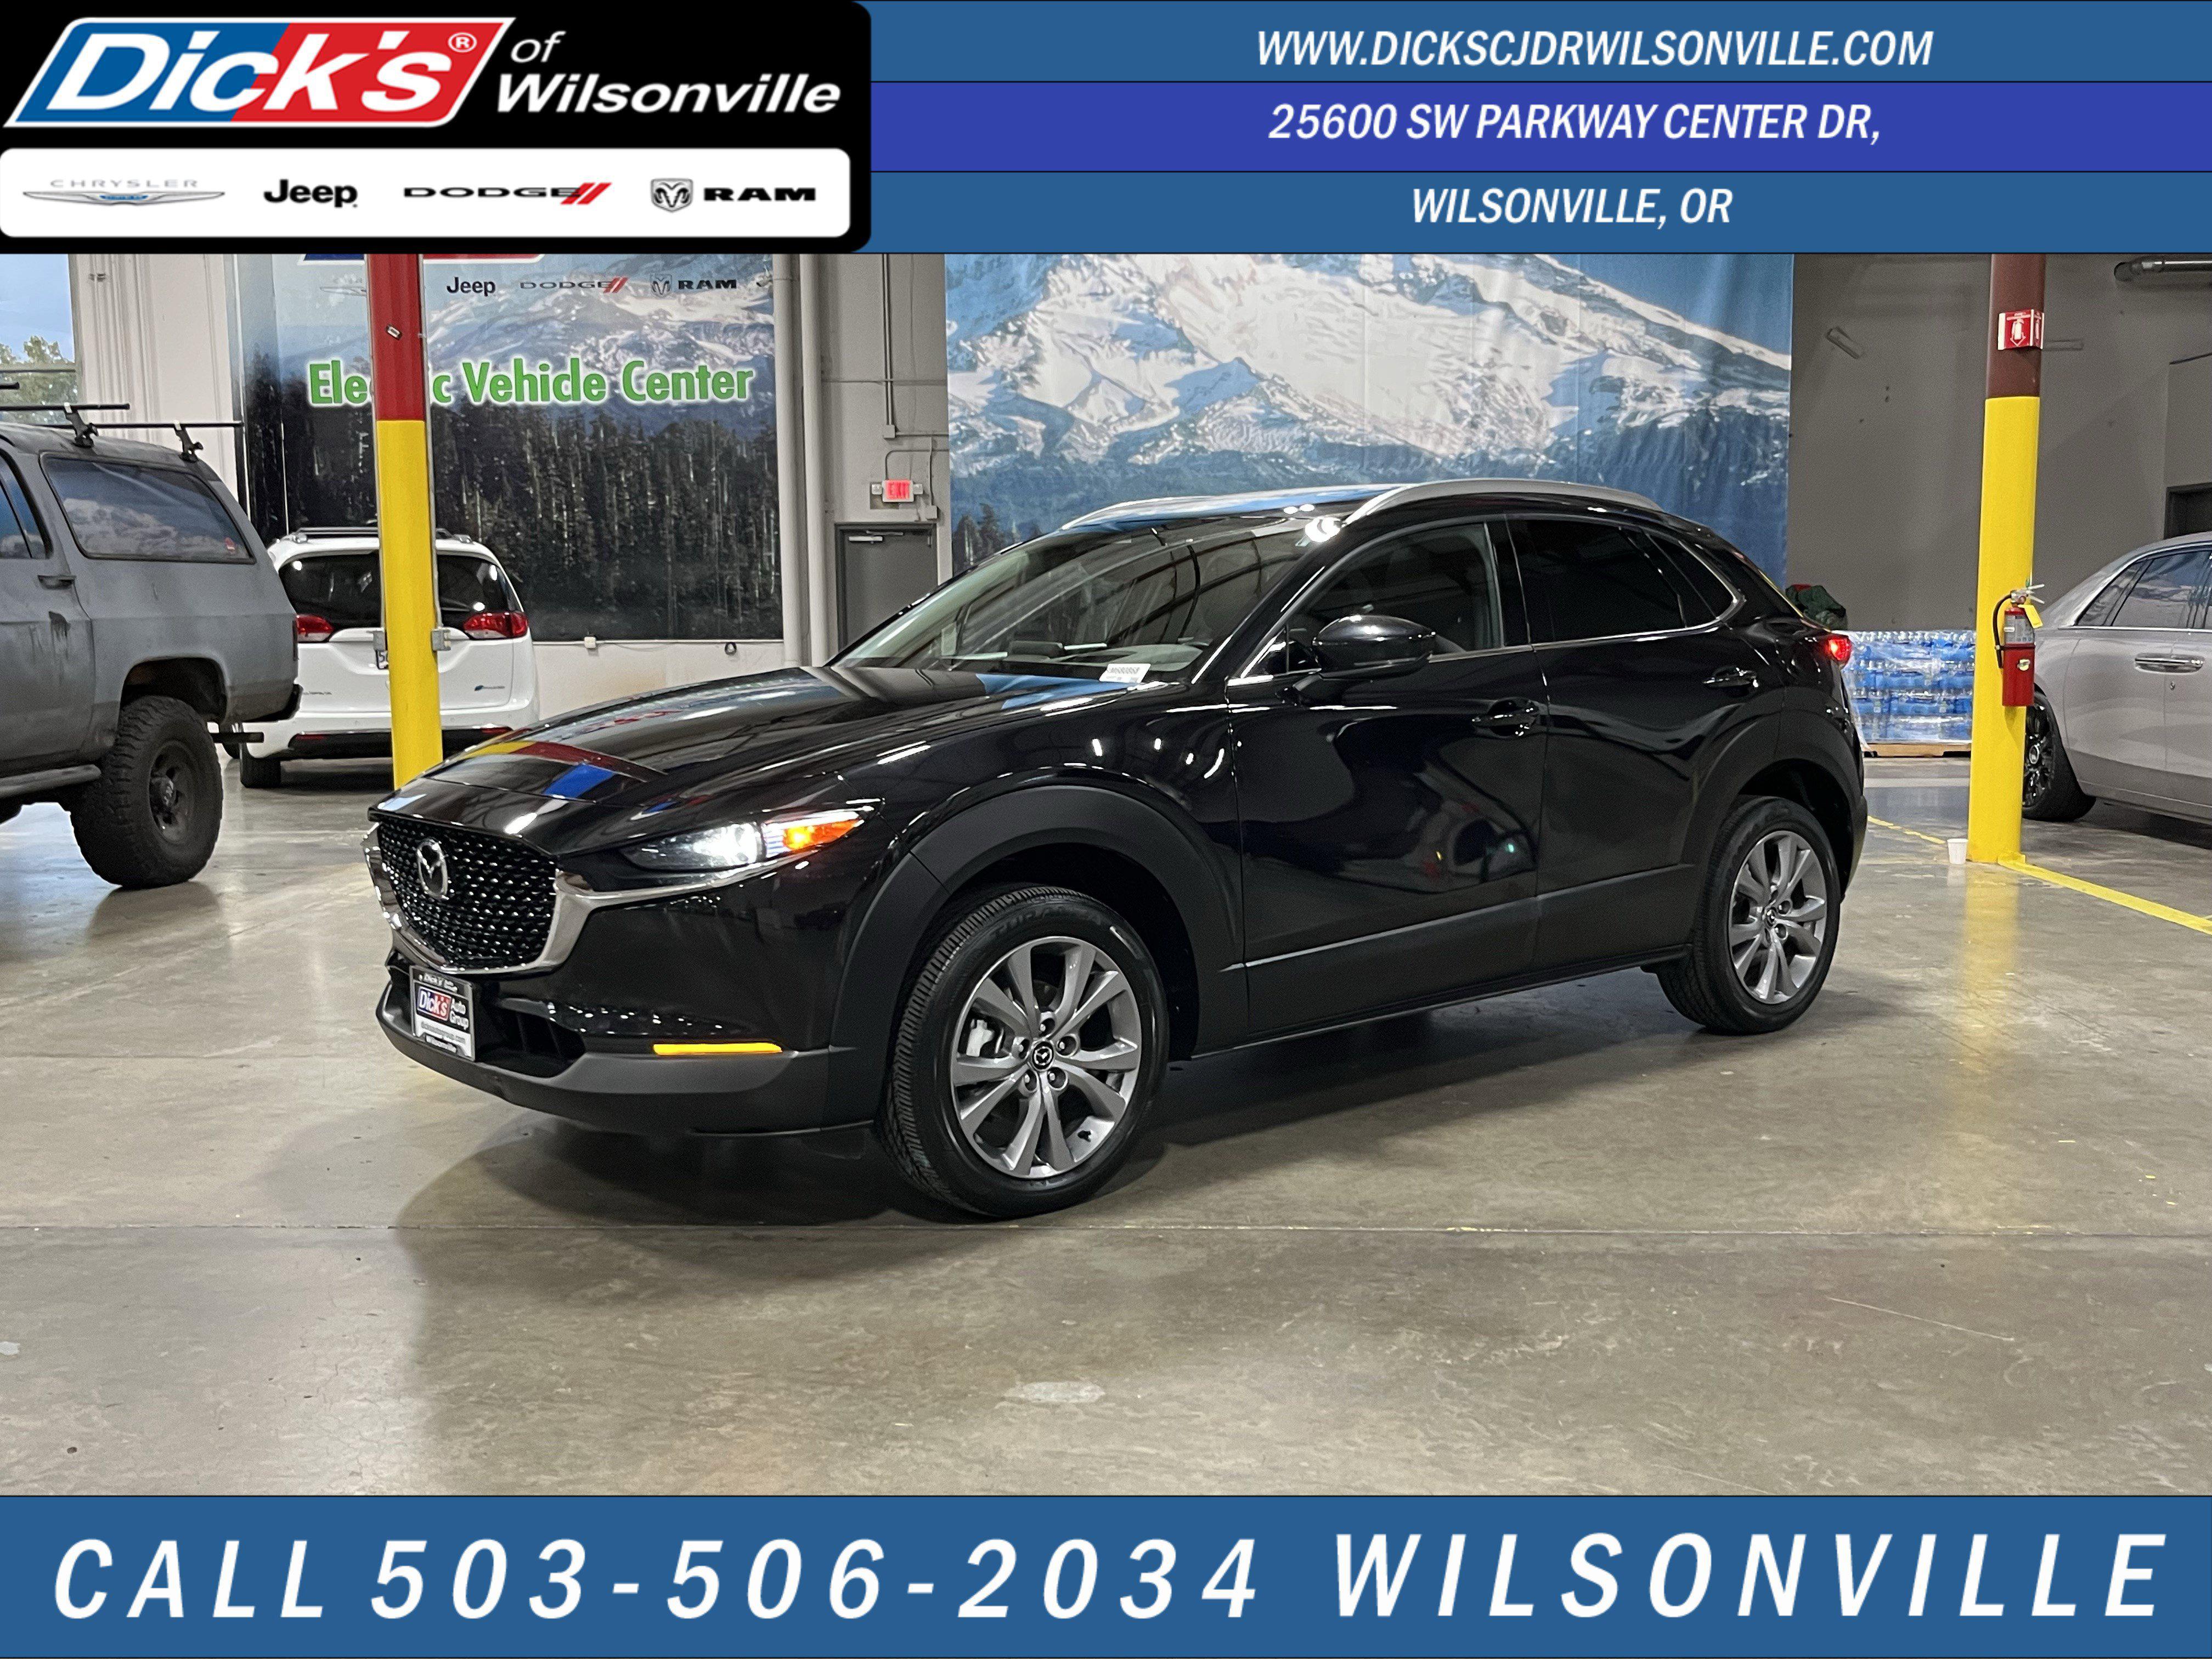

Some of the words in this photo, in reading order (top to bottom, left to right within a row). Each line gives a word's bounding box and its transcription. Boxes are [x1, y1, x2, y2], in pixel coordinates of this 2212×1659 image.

[446, 276, 495, 297] Jeep
[519, 281, 611, 290] DODGE
[678, 279, 737, 290] RAM
[309, 360, 452, 405] Elec
[462, 358, 607, 403] Vehicle
[622, 360, 754, 401] Center
[887, 482, 910, 499] EXIT
[419, 991, 448, 1017] Dick's
